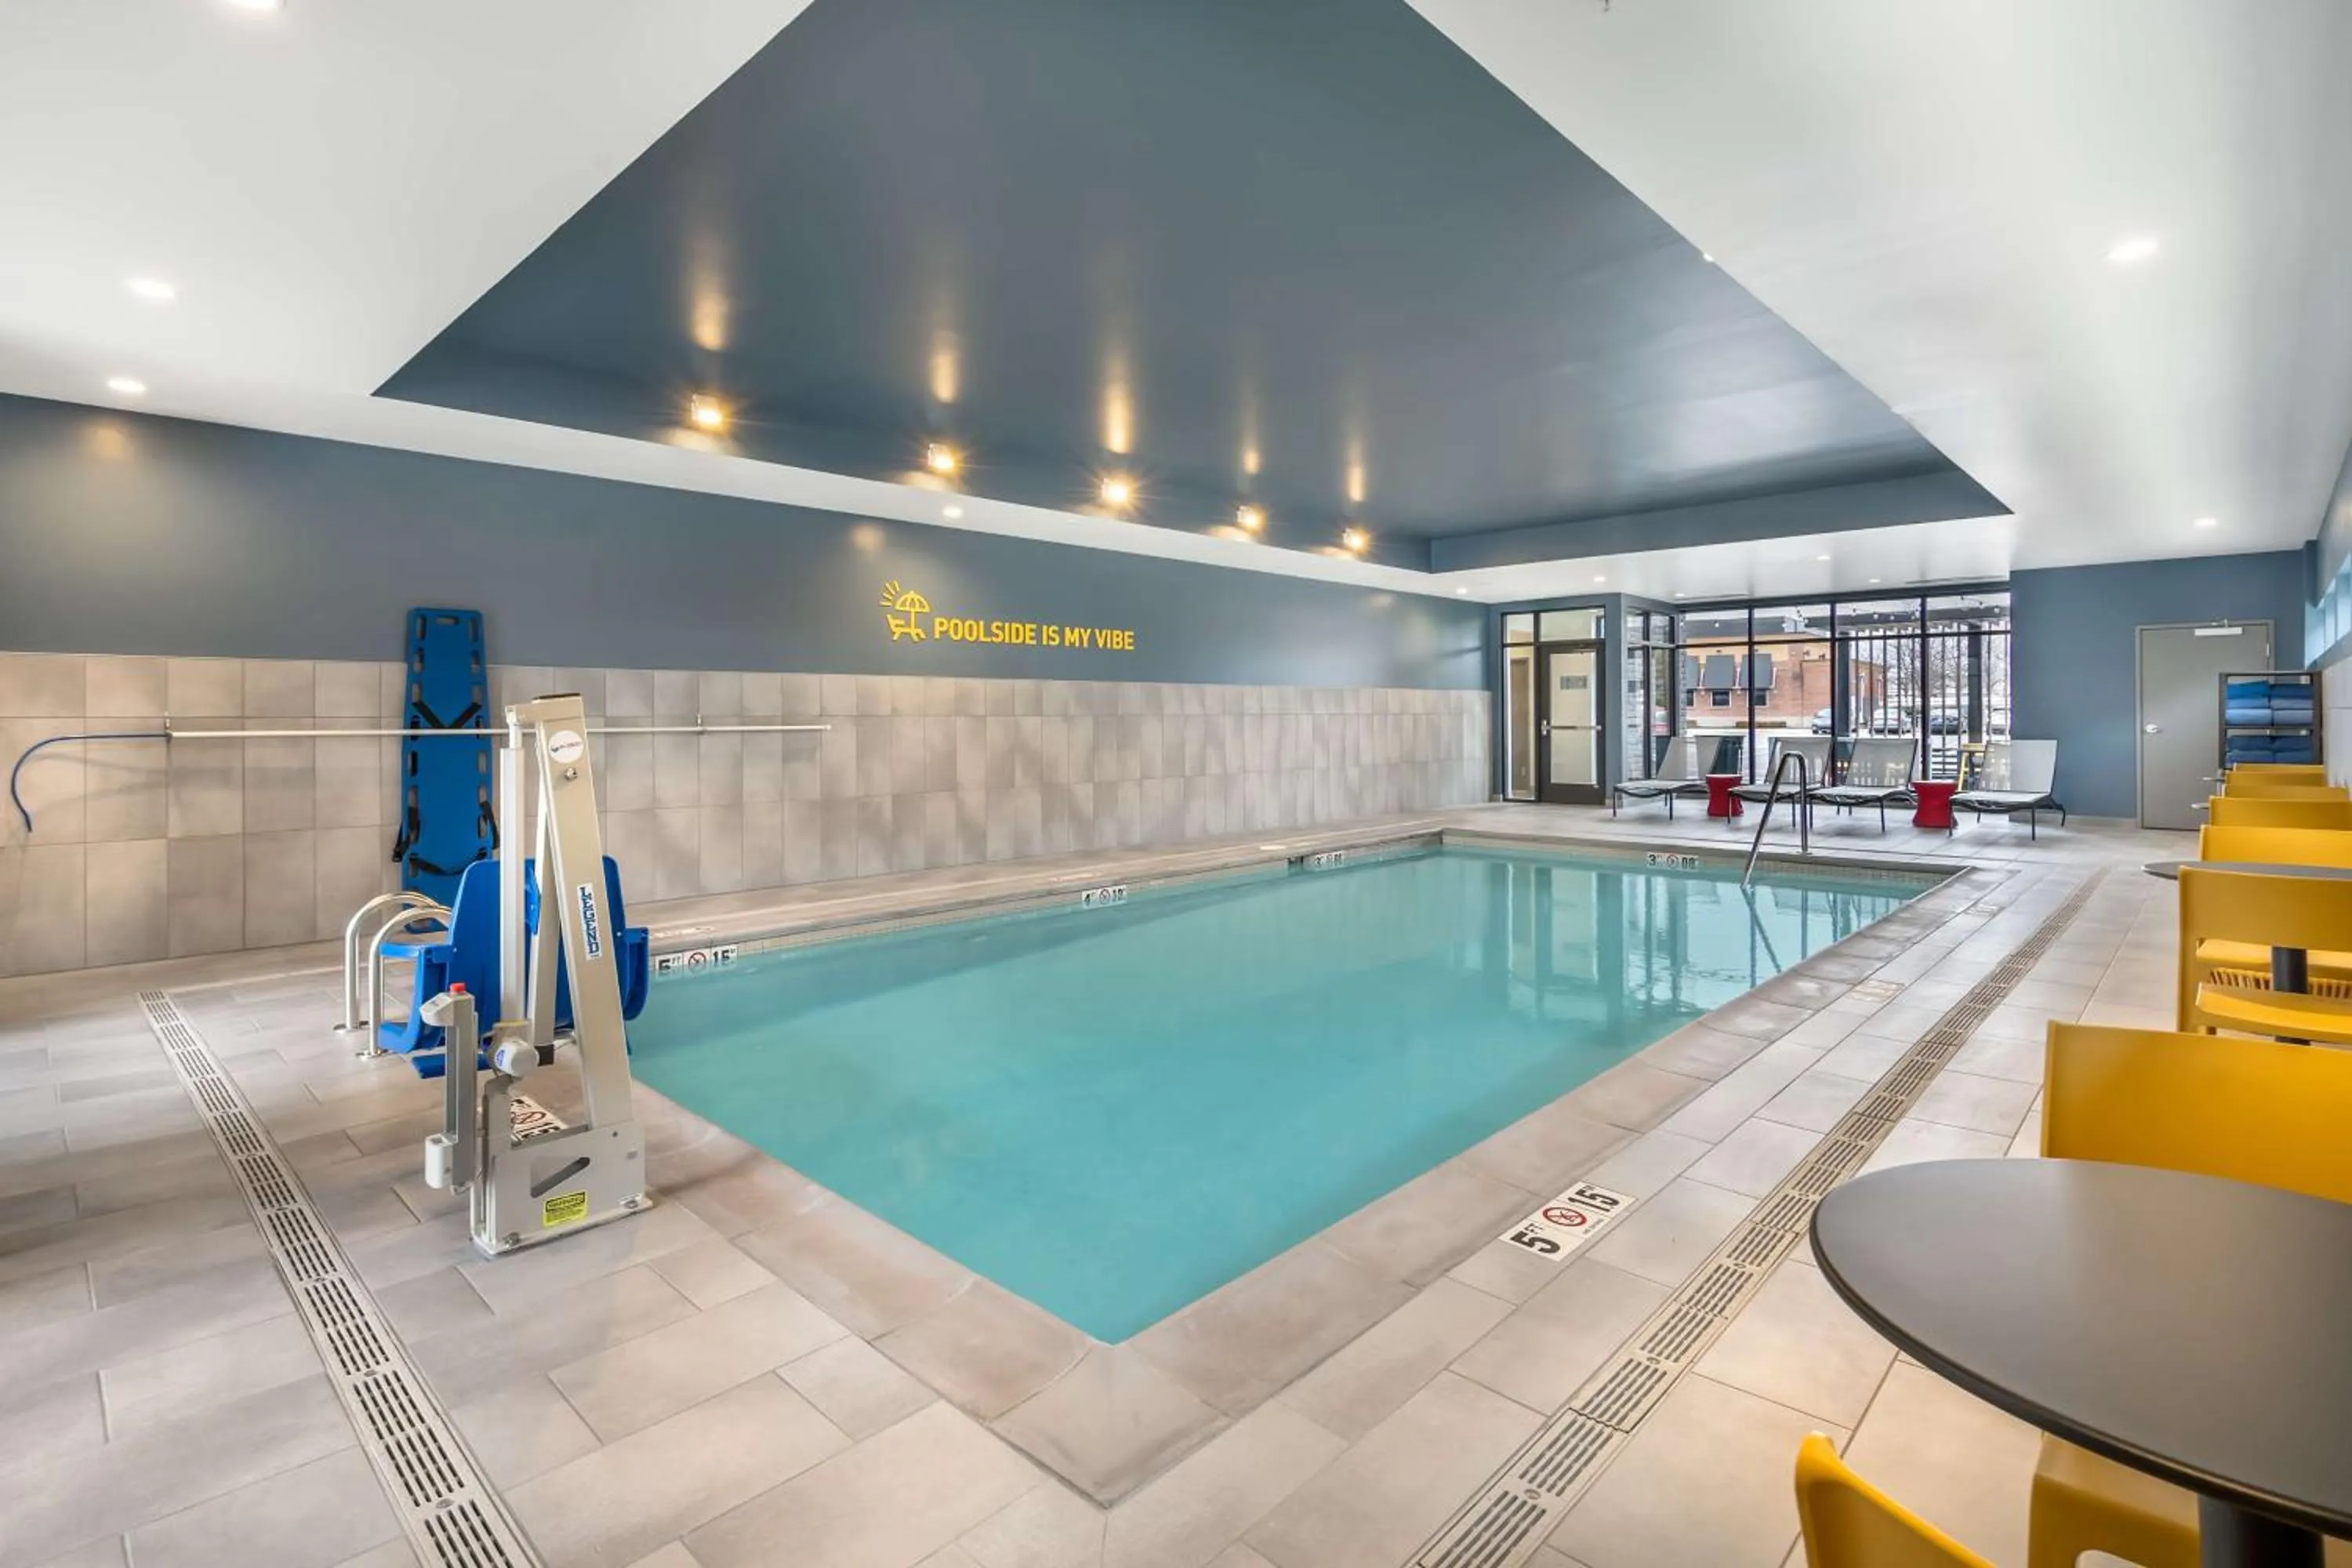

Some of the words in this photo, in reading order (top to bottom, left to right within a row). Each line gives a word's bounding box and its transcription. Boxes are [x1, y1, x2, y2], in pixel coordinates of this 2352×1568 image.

[934, 617, 1037, 646] POOLSIDE
[1042, 625, 1060, 646] IS
[1065, 627, 1091, 649] MY
[1095, 629, 1135, 651] VIBE
[579, 886, 601, 953] LEGEND
[1509, 1229, 1562, 1254] 5
